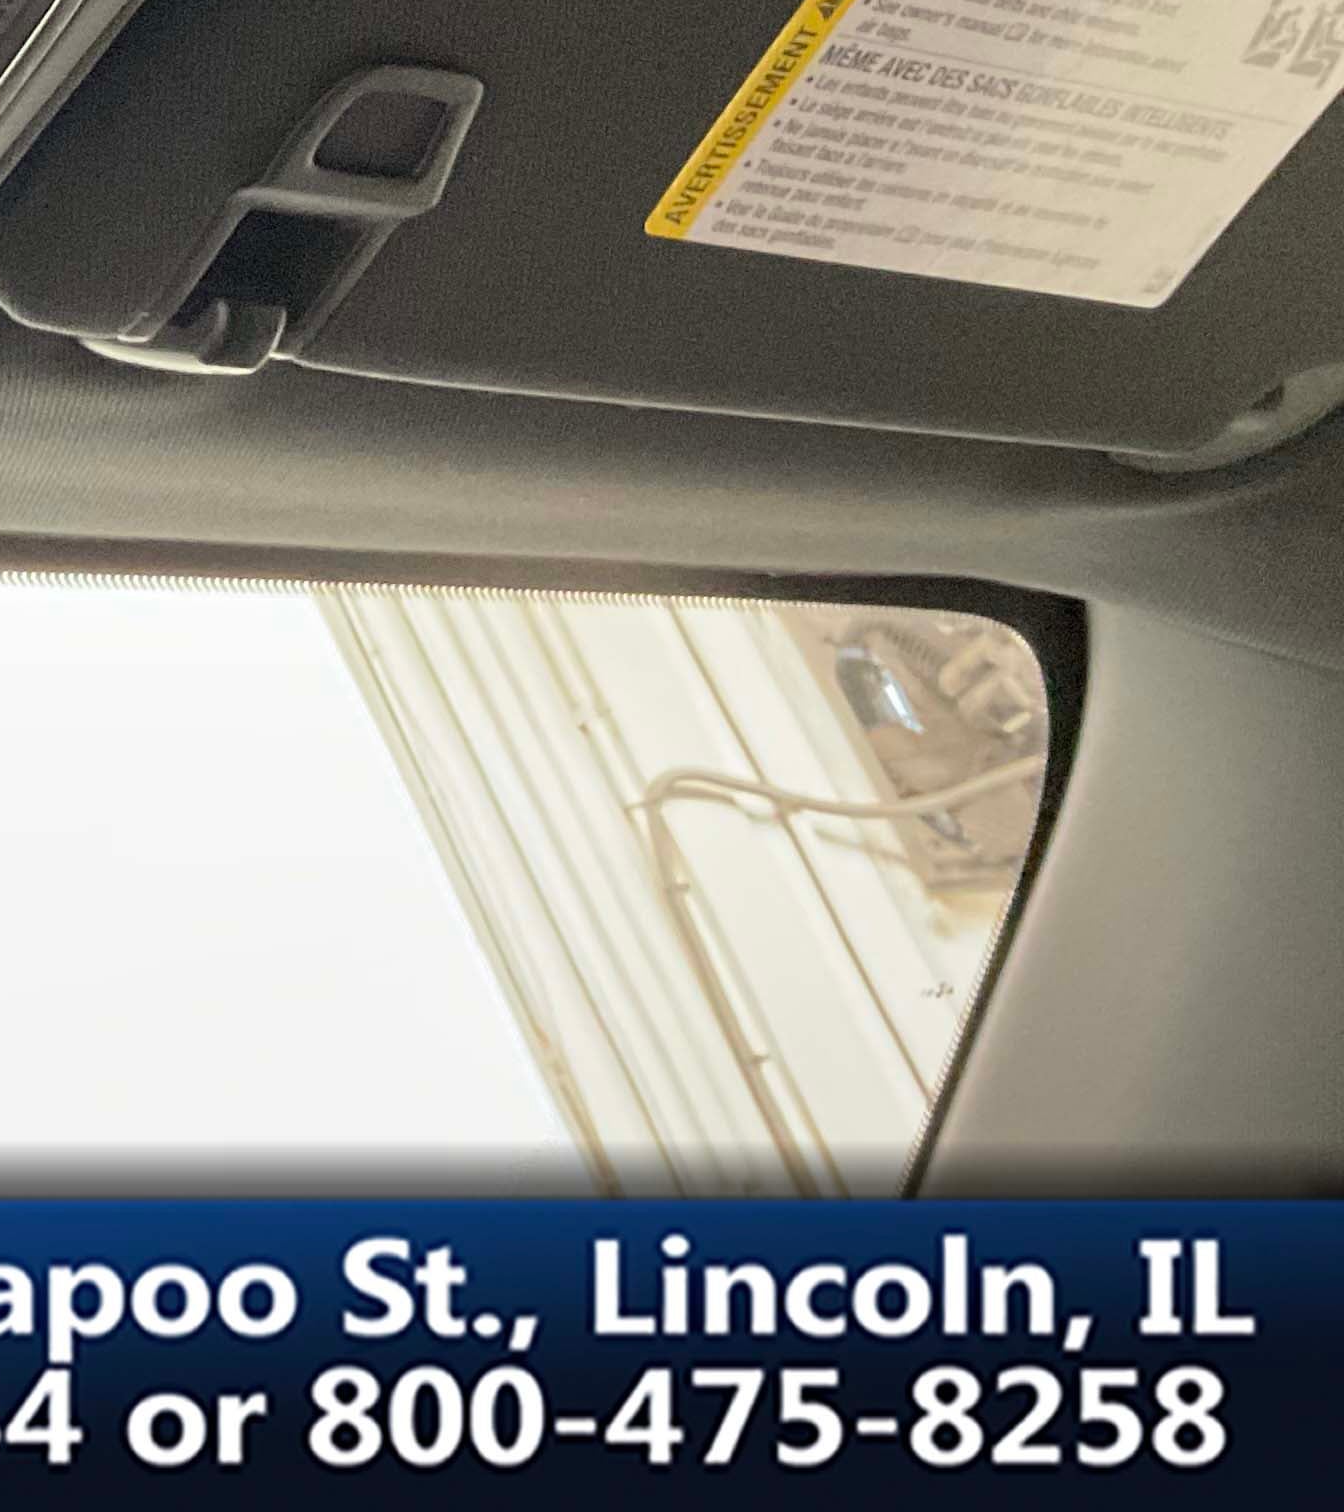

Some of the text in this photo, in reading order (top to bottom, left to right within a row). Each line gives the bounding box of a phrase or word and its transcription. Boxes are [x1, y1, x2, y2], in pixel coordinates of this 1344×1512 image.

[665, 29, 818, 225] AVERTISSEMENT
[818, 41, 884, 72] MÊME
[878, 57, 931, 82] AVEC
[928, 65, 970, 89] DES
[966, 74, 1019, 99] SACS
[1014, 82, 1125, 118] GONFLABLES
